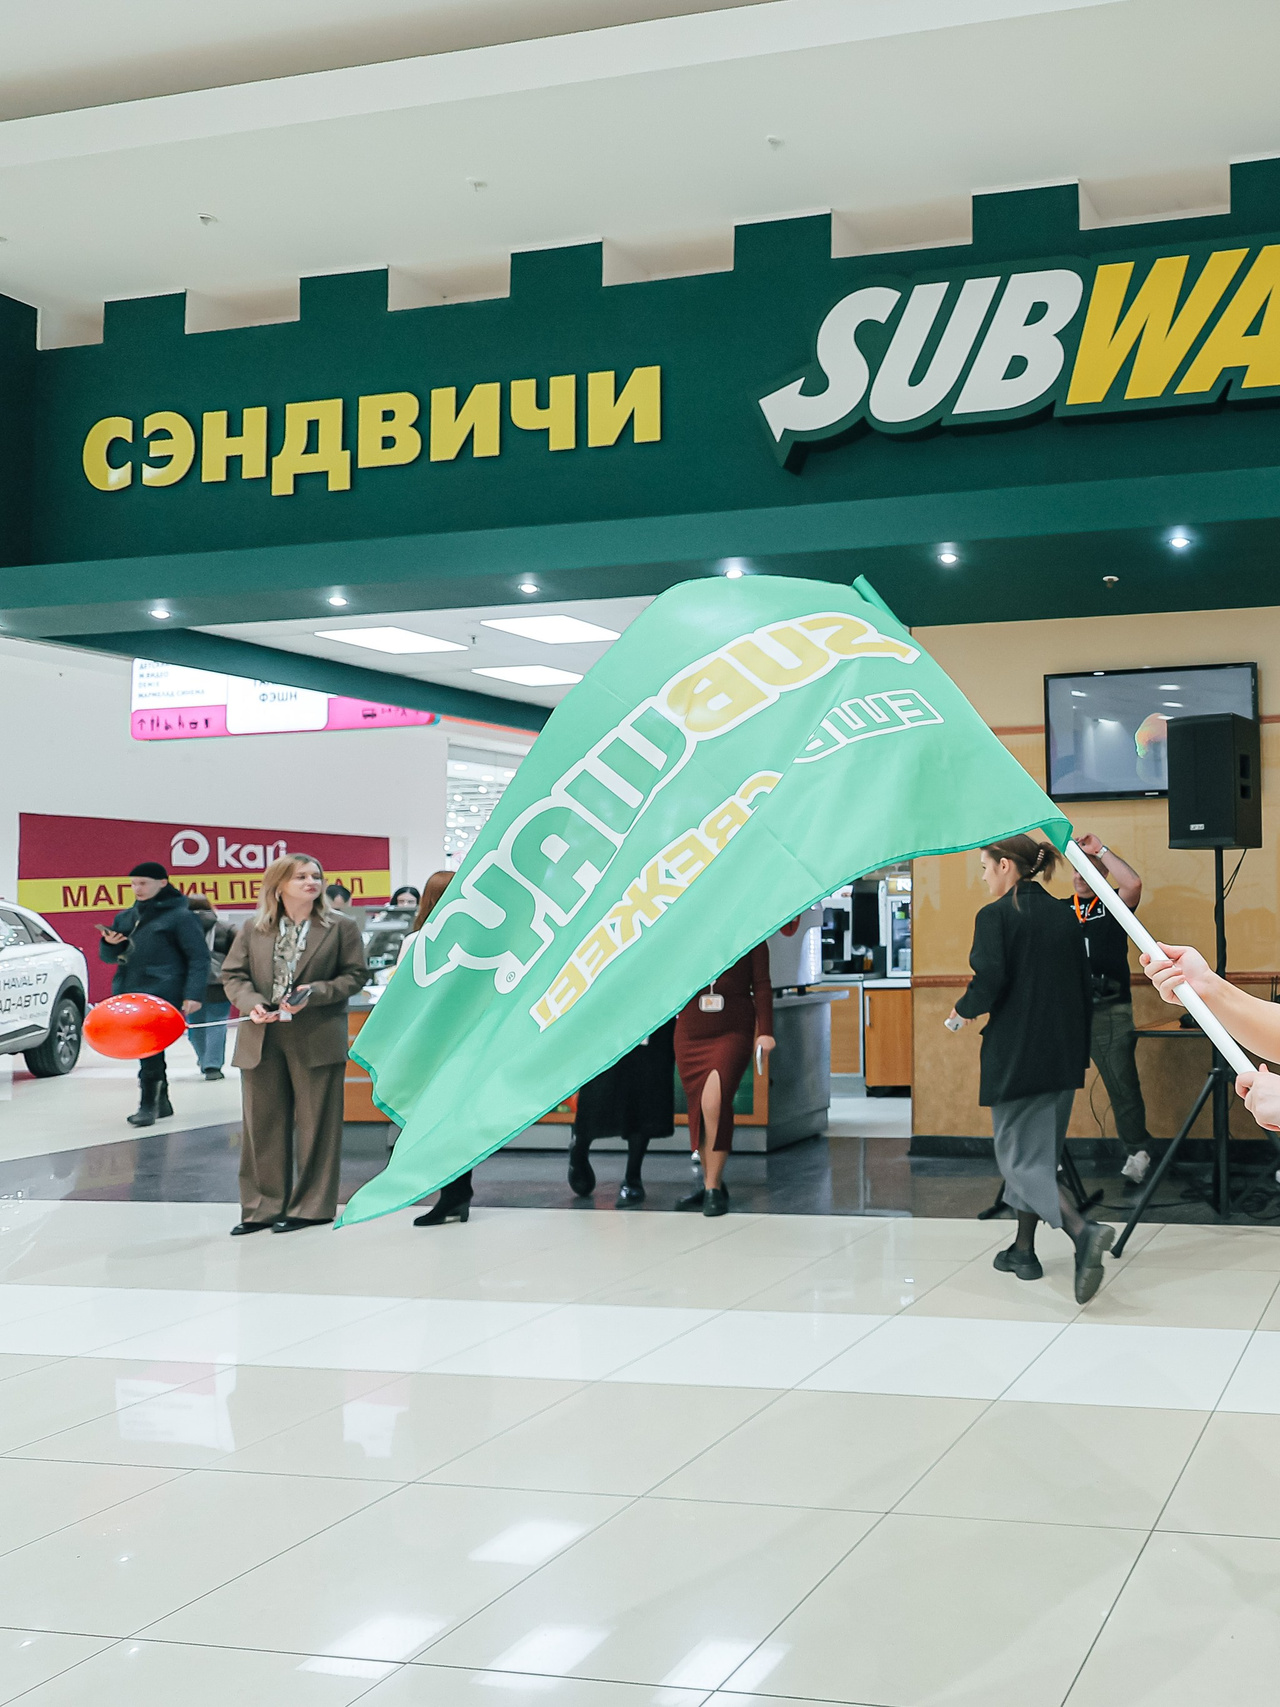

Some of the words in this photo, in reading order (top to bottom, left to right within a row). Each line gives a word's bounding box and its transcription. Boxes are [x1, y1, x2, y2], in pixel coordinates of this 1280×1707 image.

[259, 691, 298, 703] ФЭШН
[62, 880, 218, 908] МАГИН
[3, 975, 33, 991] HAVAL
[36, 972, 48, 985] F7
